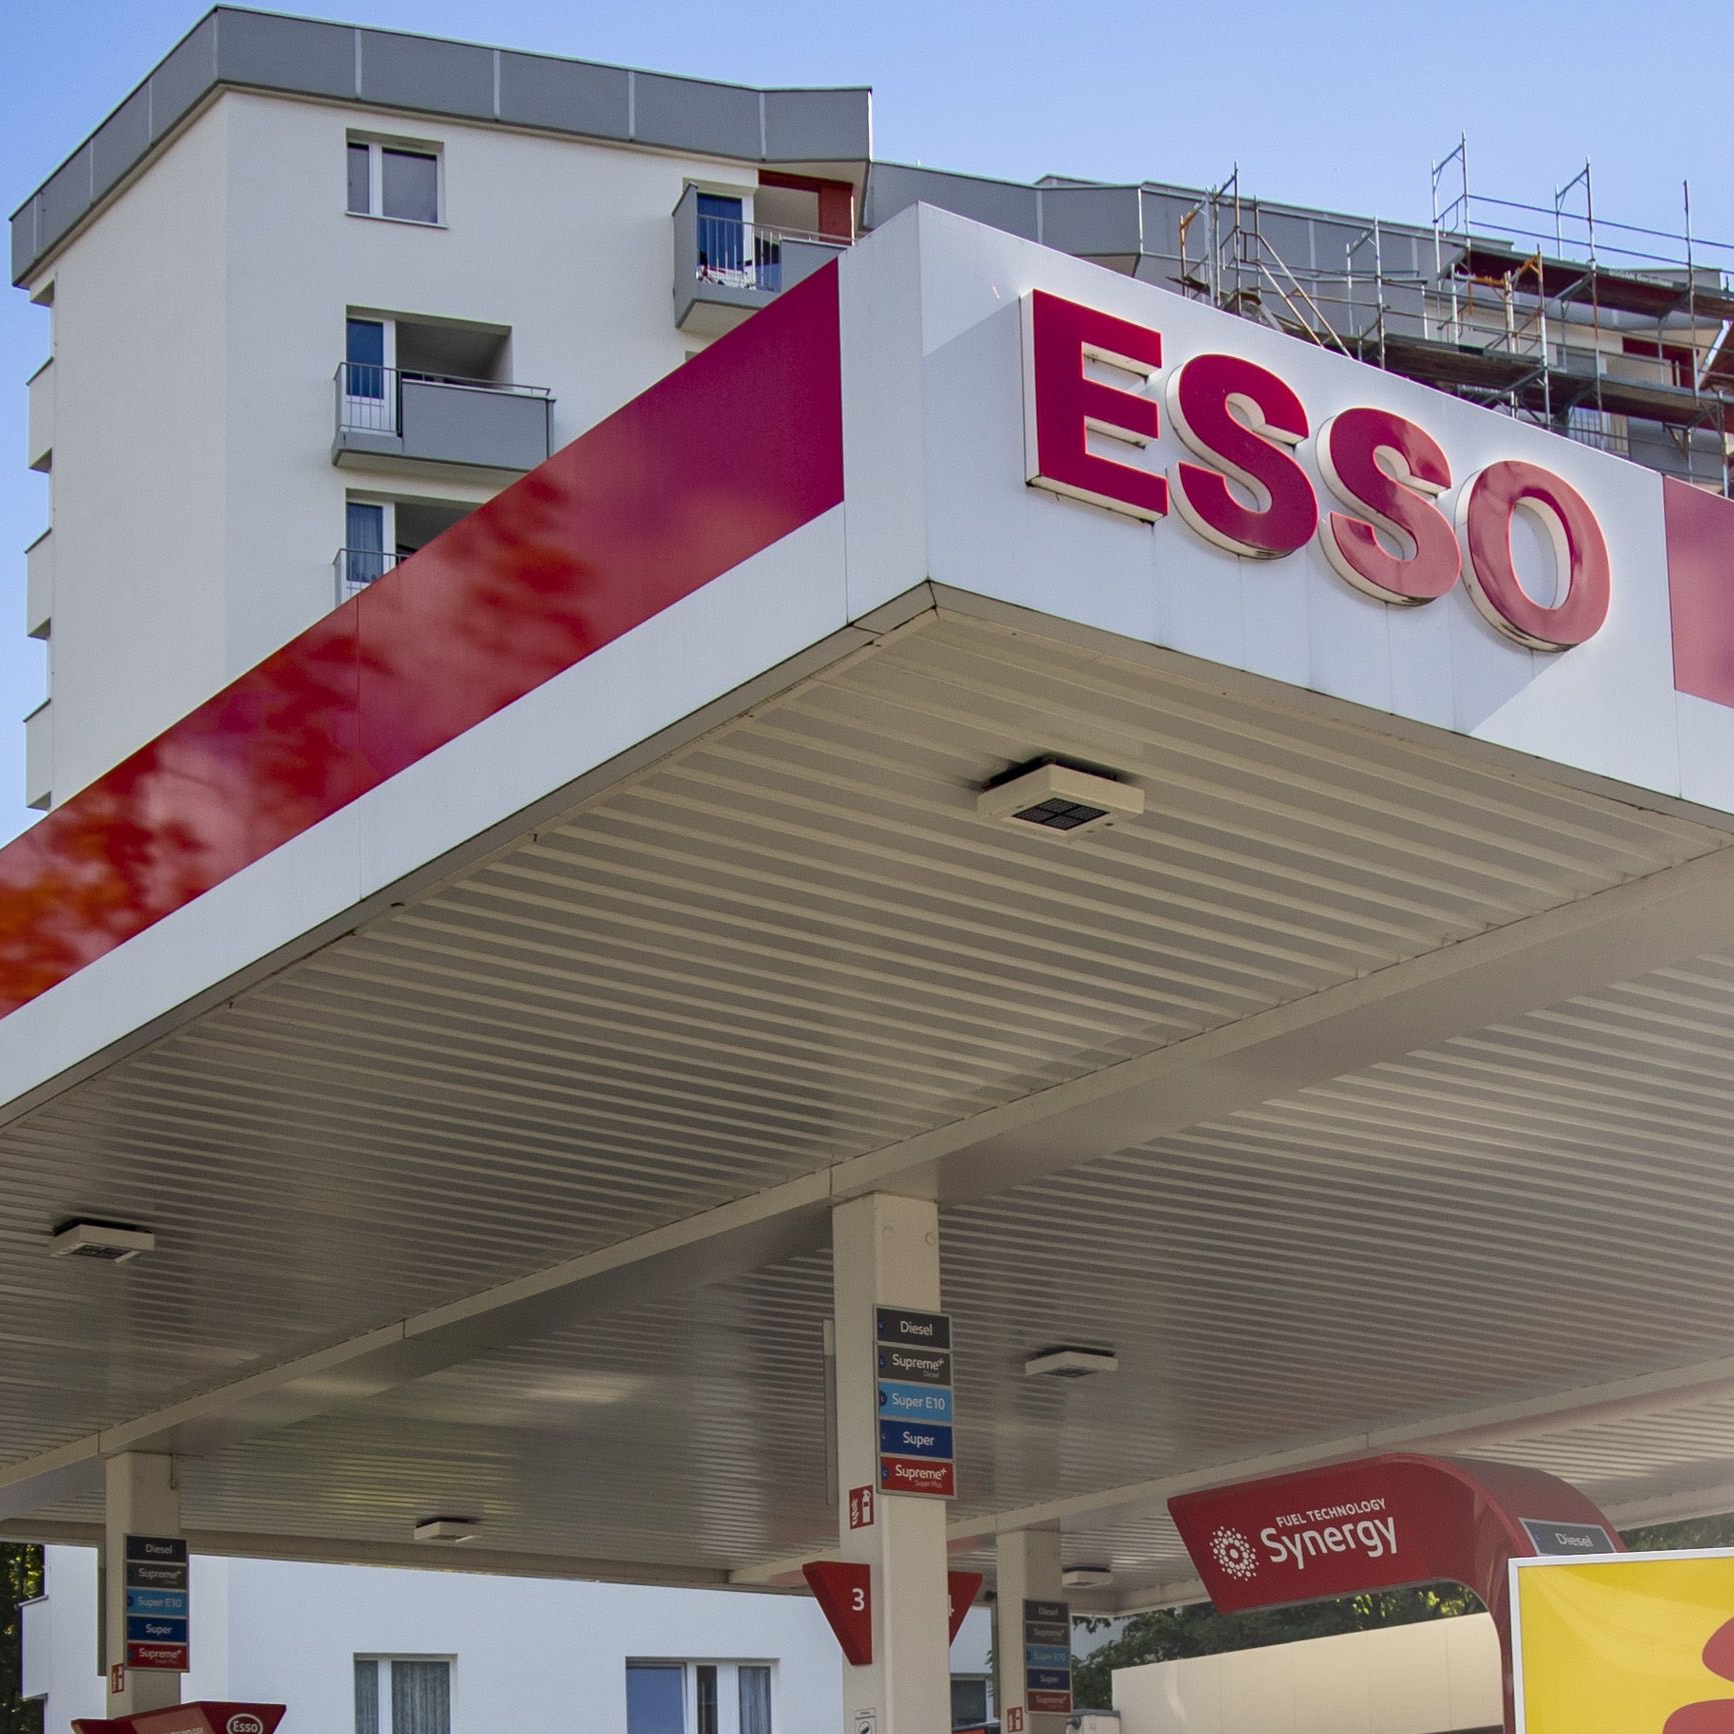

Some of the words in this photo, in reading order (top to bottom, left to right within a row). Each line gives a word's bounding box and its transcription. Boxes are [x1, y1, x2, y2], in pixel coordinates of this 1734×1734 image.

[1020, 289, 1611, 653] ESSO
[900, 1321, 933, 1337] Diesel
[892, 1393, 923, 1409] Super
[925, 1396, 946, 1411] E10
[902, 1431, 935, 1448] Super
[1276, 1513, 1307, 1528] FUEL
[1306, 1498, 1386, 1522] TECHNOLOGY
[1260, 1516, 1398, 1570] Synergy
[1554, 1532, 1594, 1547] Diesel
[145, 1543, 173, 1555] Diesel
[137, 1597, 164, 1608] Super
[851, 1587, 865, 1612] 3
[1038, 1606, 1059, 1616] Diesel
[145, 1623, 173, 1636] Super
[1040, 1674, 1060, 1684] Super
[231, 1720, 258, 1733] Esso
